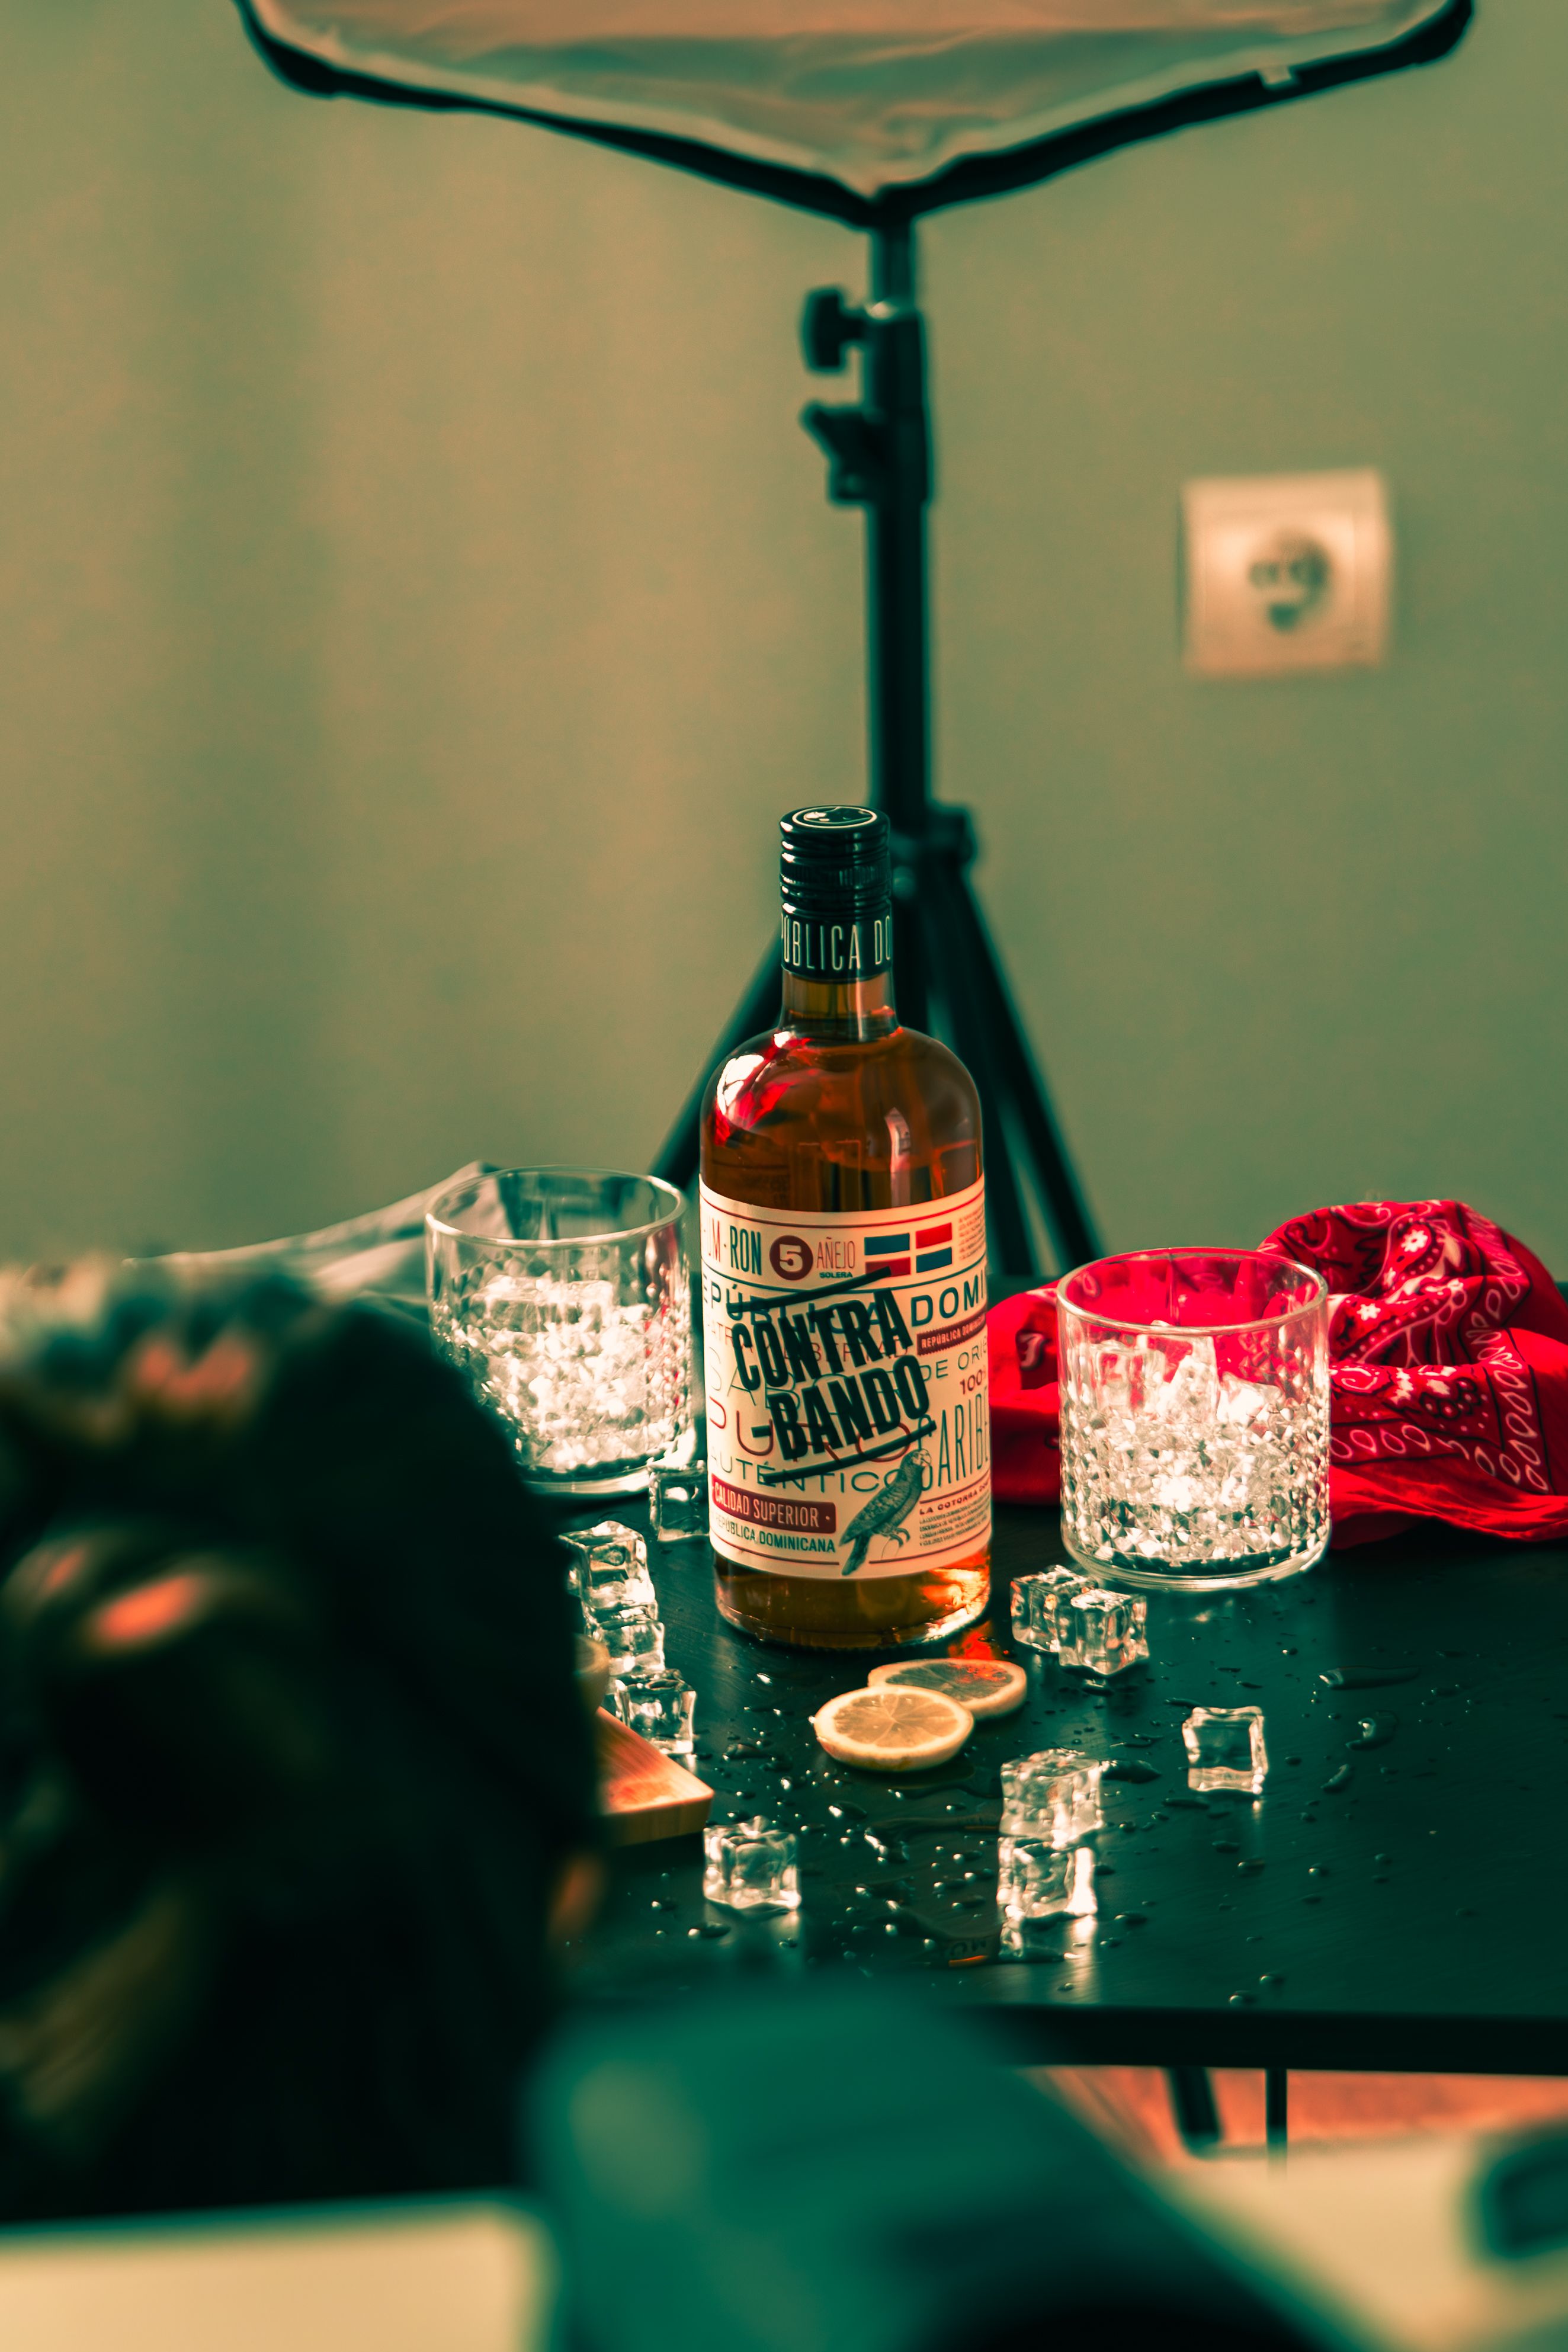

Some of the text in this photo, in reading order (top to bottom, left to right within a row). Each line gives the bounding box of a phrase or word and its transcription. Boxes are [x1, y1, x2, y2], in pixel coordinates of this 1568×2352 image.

[729, 1225, 762, 1276] RON
[779, 1244, 803, 1273] 5
[816, 1236, 855, 1269] AÑEJO
[732, 1287, 913, 1390] CONTRA
[960, 1364, 986, 1395] 100
[714, 1481, 819, 1528] CALIDAD SUPERIOR
[759, 1531, 836, 1553] DOMINICANA
